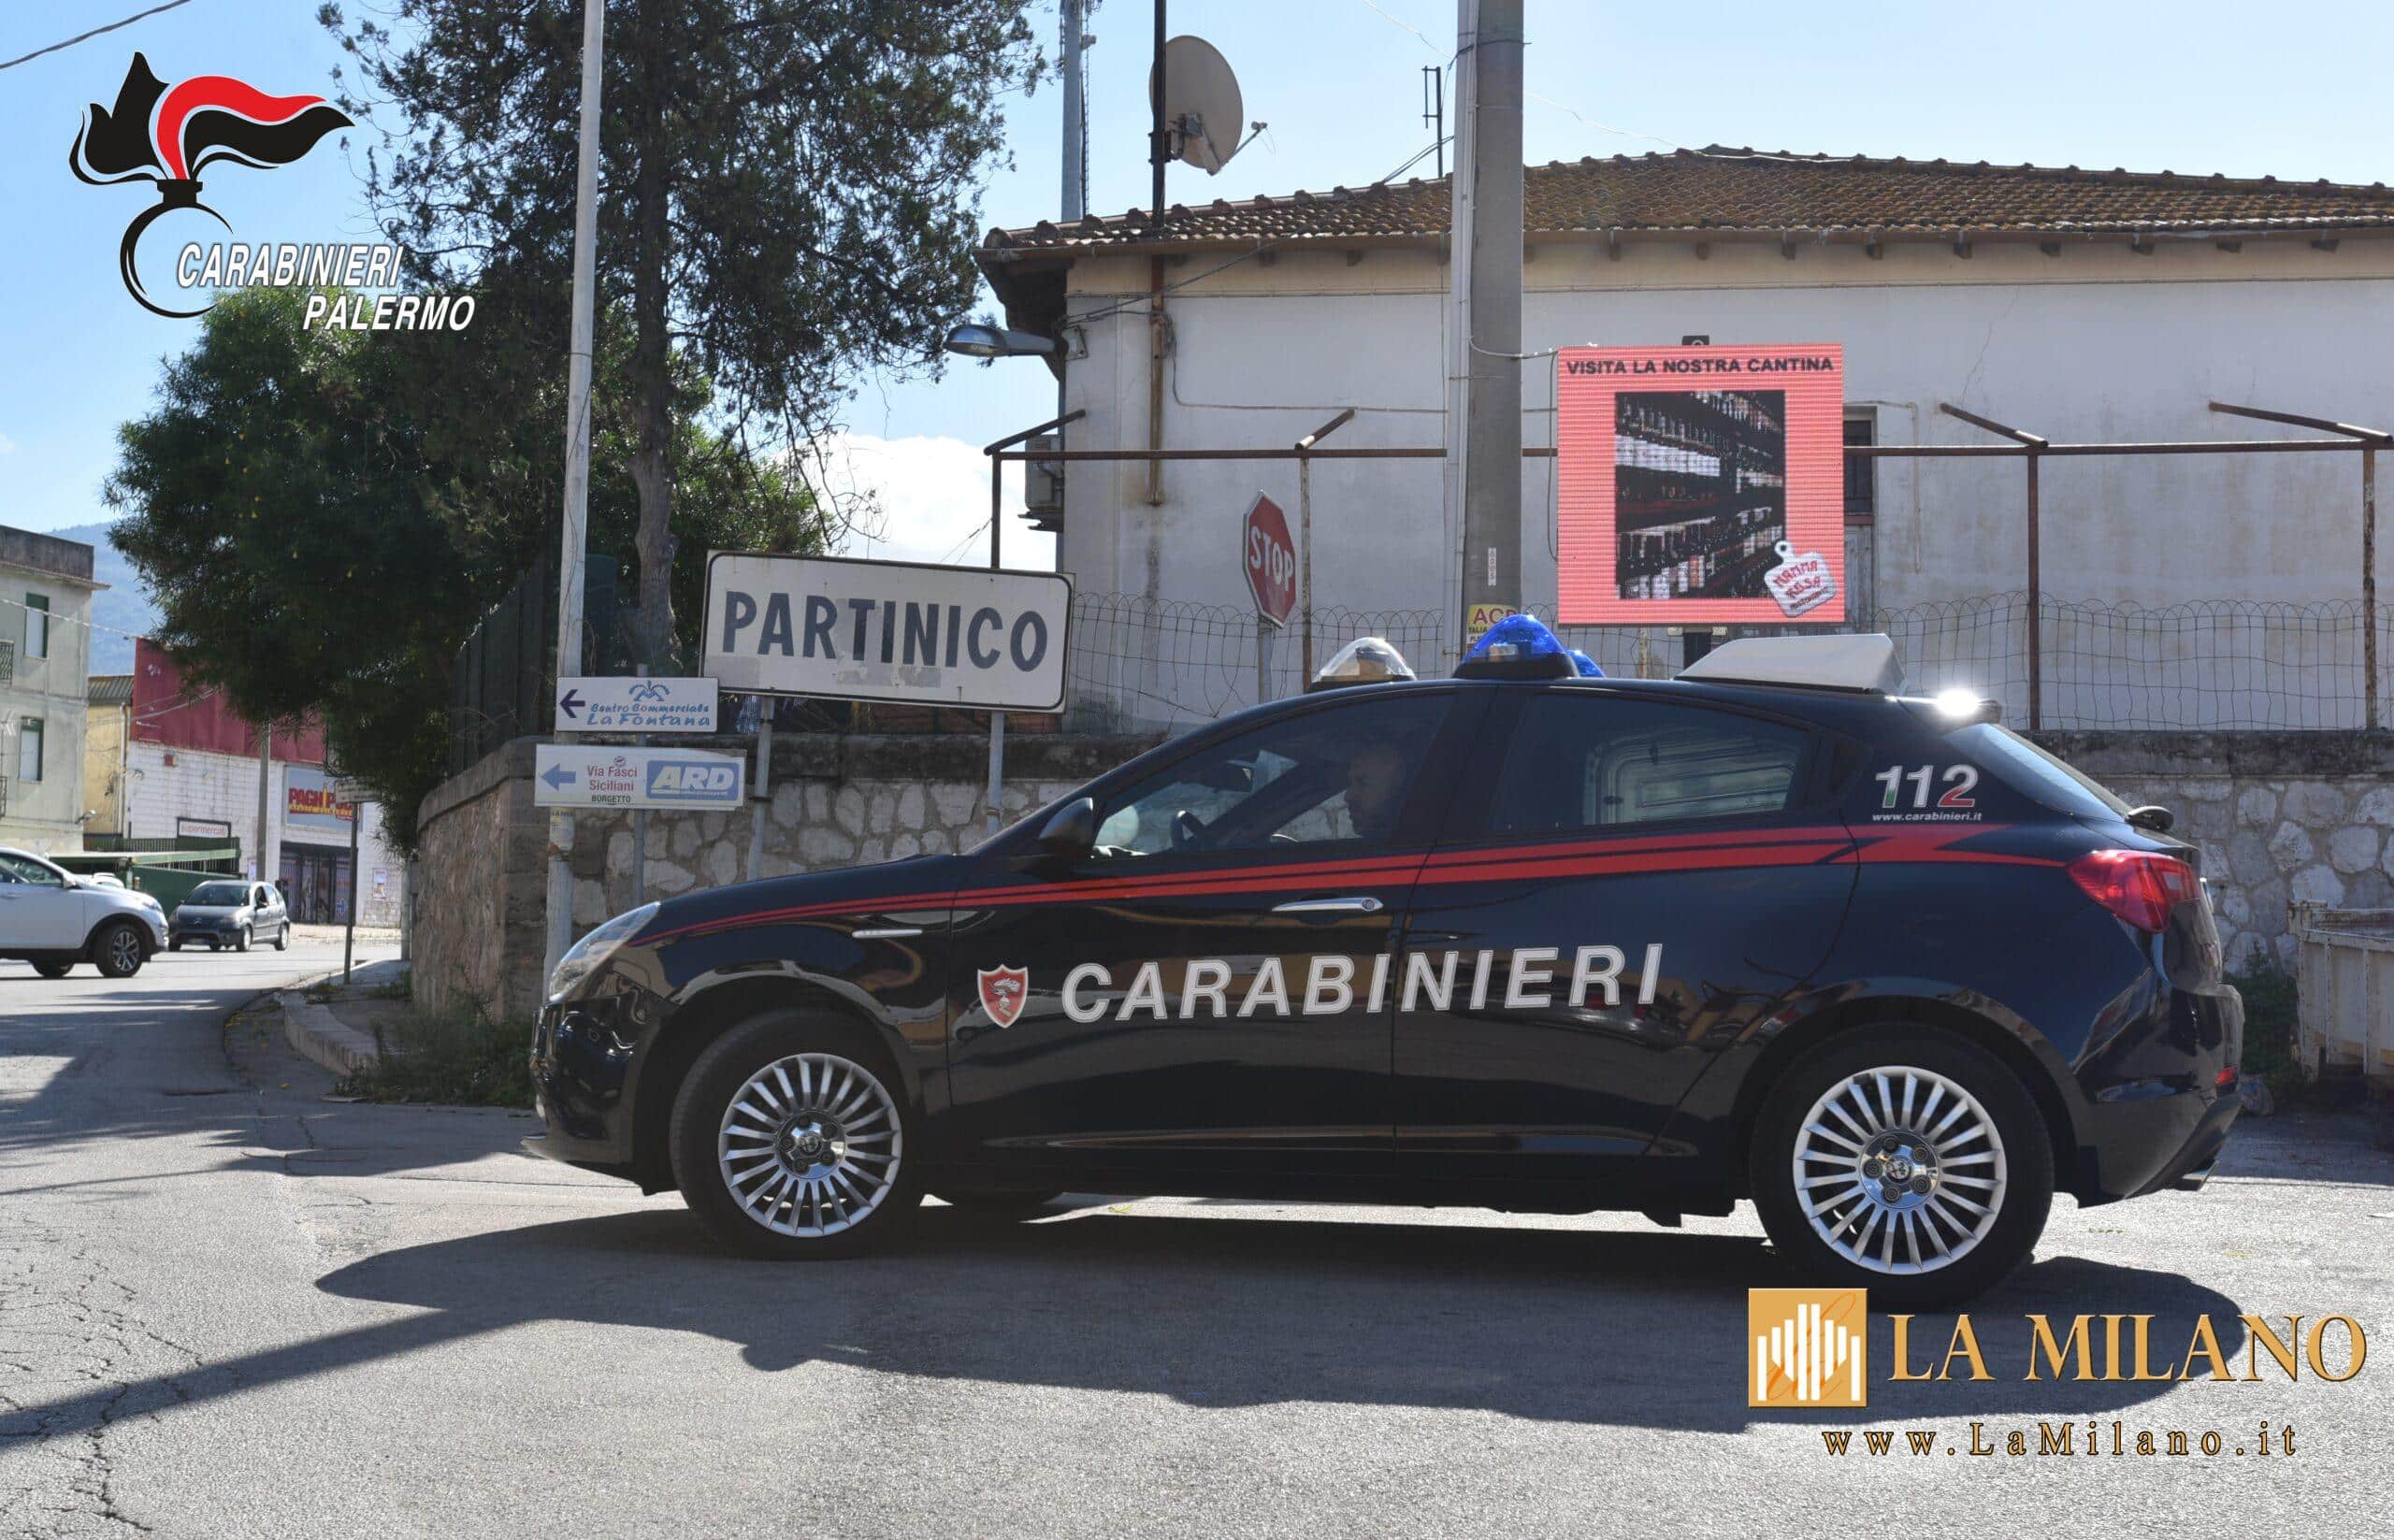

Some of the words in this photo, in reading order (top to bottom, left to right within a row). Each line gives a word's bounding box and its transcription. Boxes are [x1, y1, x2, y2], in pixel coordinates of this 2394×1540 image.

[1566, 359, 1627, 374] VISITA
[1633, 359, 1657, 373] LA
[1663, 358, 1741, 373] NOSTRA
[1747, 357, 1835, 372] CANTINA
[1250, 525, 1293, 592] STOP
[723, 591, 1047, 672] PARTINICO
[590, 702, 629, 712] Centro
[587, 713, 613, 726] La
[618, 712, 710, 726] Fontana
[587, 765, 604, 777] Via
[608, 765, 638, 778] Fasci
[650, 766, 735, 790] ARD
[589, 779, 634, 791] Siciliani
[1875, 764, 1979, 809] 112
[591, 795, 631, 803] BORGETTO
[1872, 812, 1983, 822] www.carabinieri.it
[1060, 943, 1664, 1023] CARABINIERI
